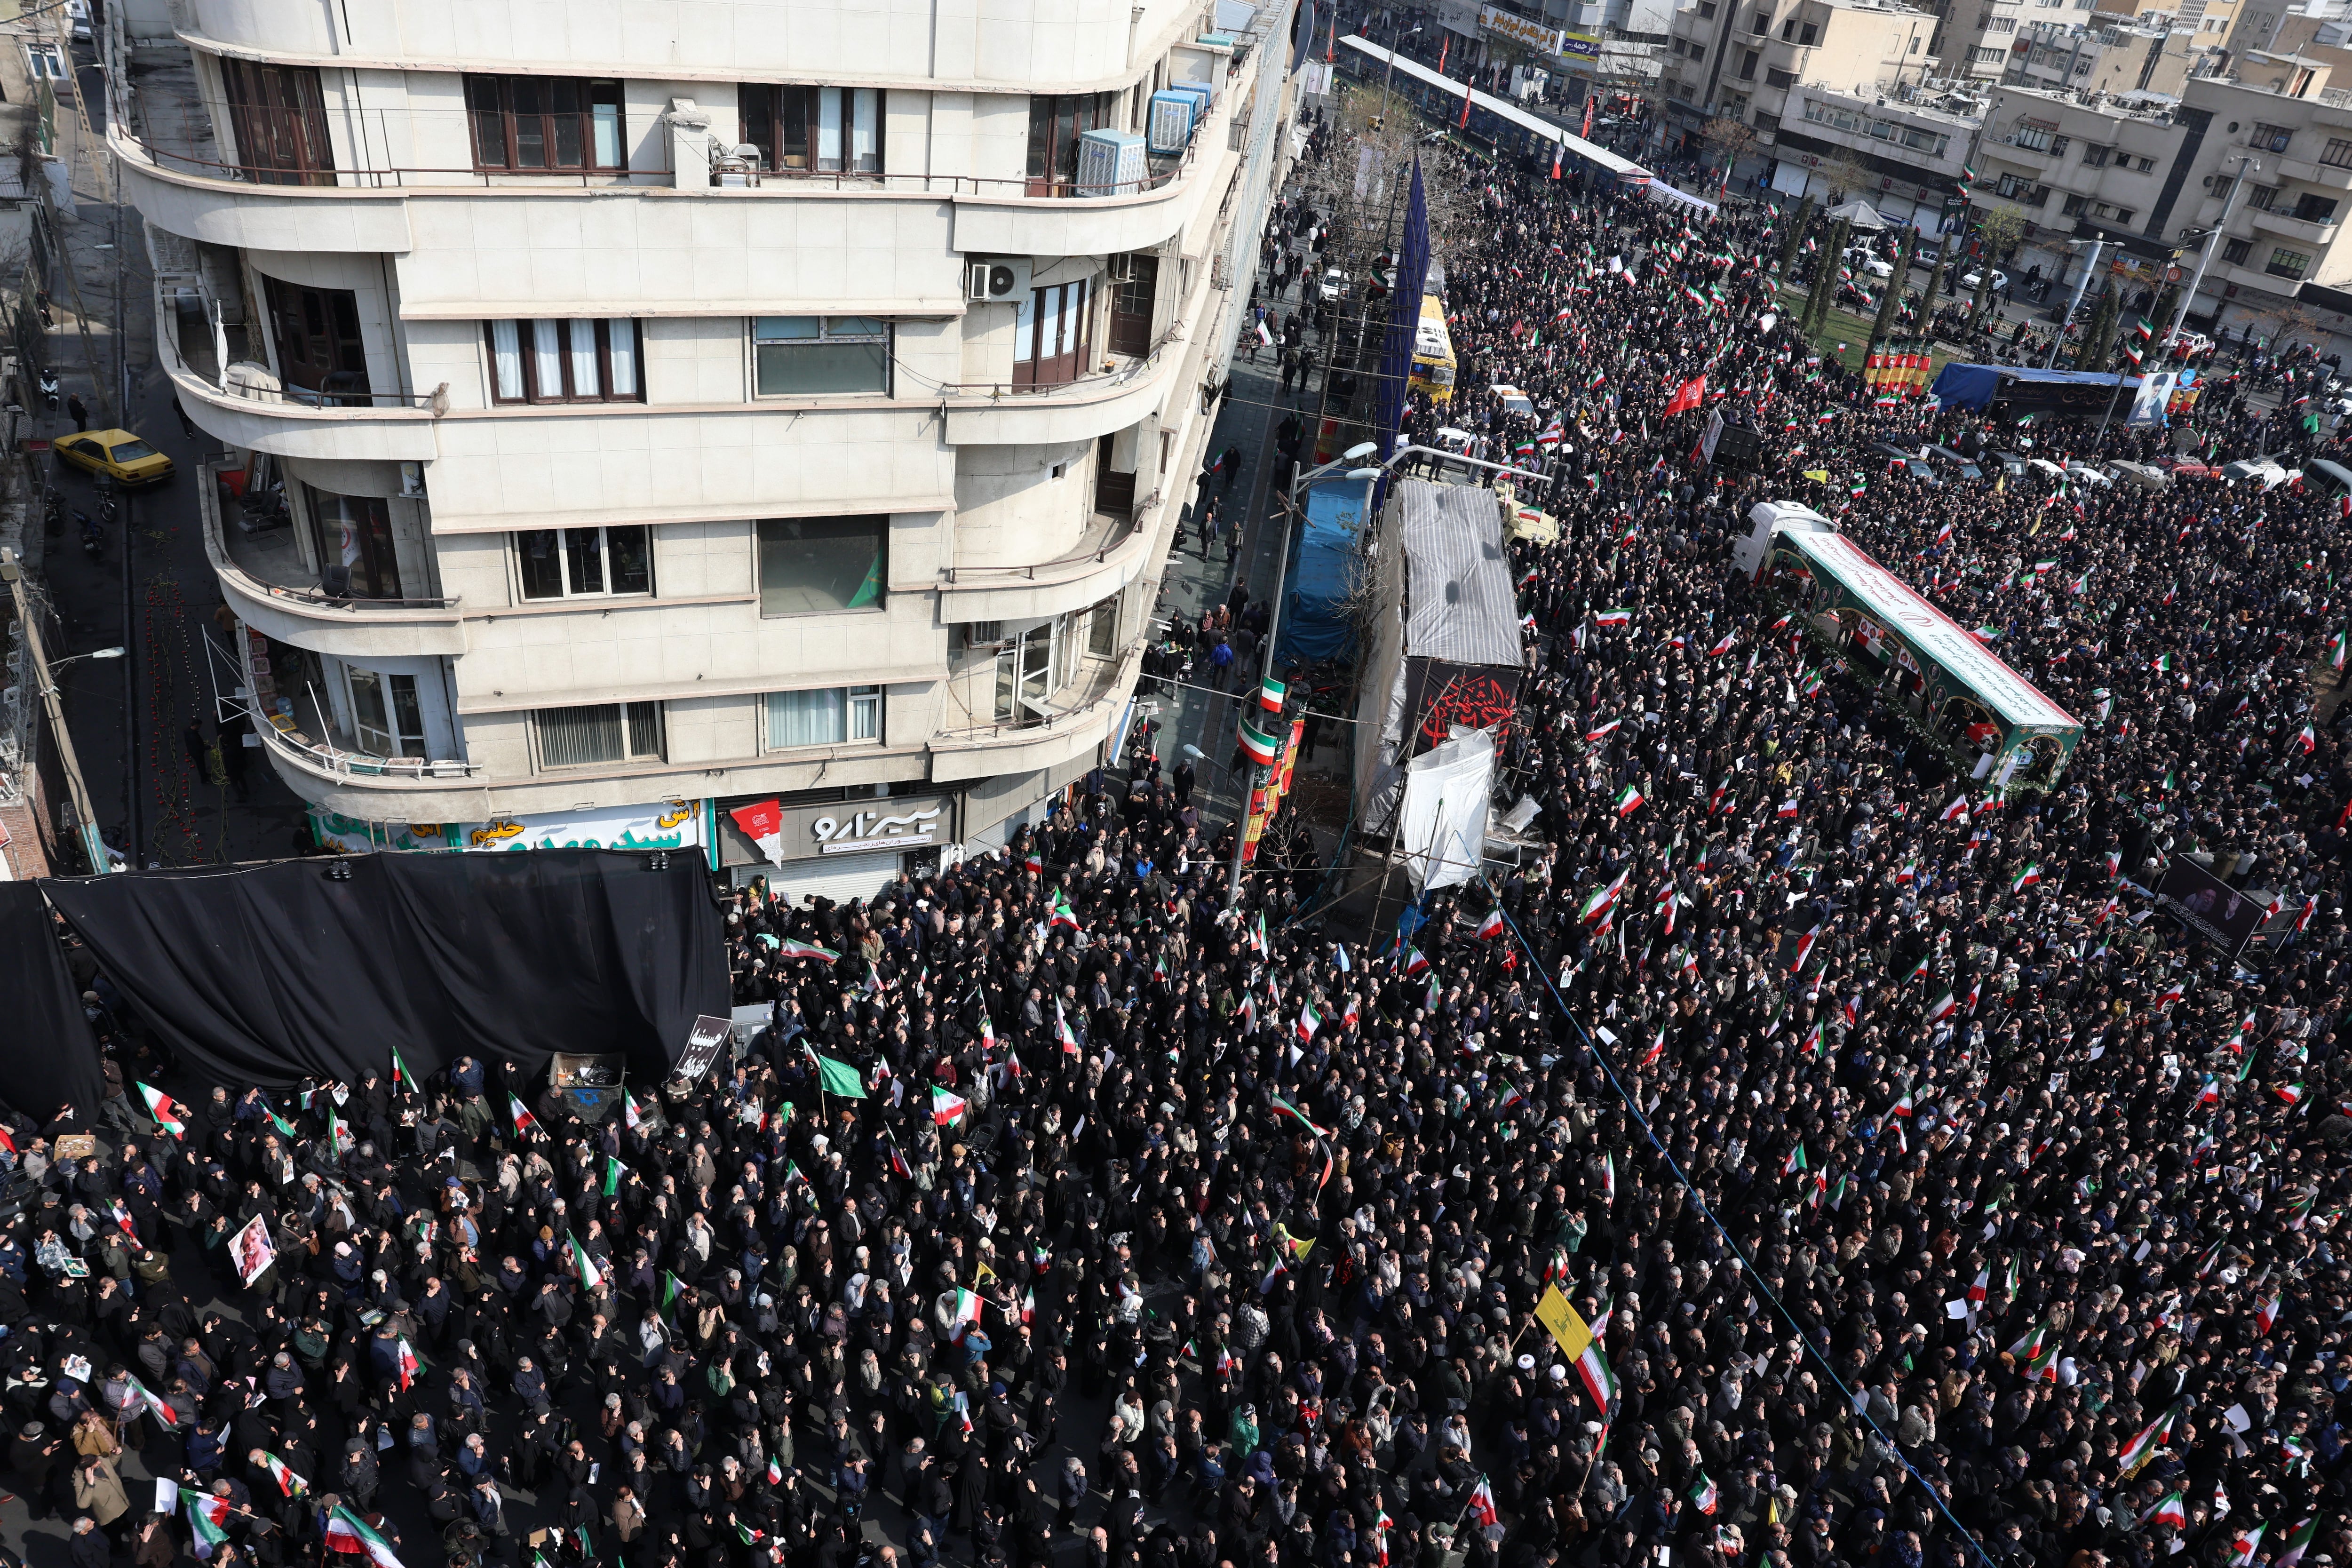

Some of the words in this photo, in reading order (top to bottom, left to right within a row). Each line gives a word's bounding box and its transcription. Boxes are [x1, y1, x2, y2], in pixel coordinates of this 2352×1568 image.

[1573, 42, 1595, 54] ترجمه
[1881, 590, 1907, 605] اسلامی
[1941, 645, 1960, 656] چتر
[1953, 656, 1974, 667] قرآن
[1971, 670, 1995, 685] اسلام
[1990, 685, 2018, 705] تضمین
[2010, 705, 2030, 716] کرده
[1947, 638, 1962, 649] ملت
[1956, 649, 1978, 660] ایران
[1989, 671, 2010, 685] پیروز
[2005, 685, 2031, 706] خواهد
[2028, 705, 2045, 716] شد
[690, 1027, 723, 1051] حسینیه
